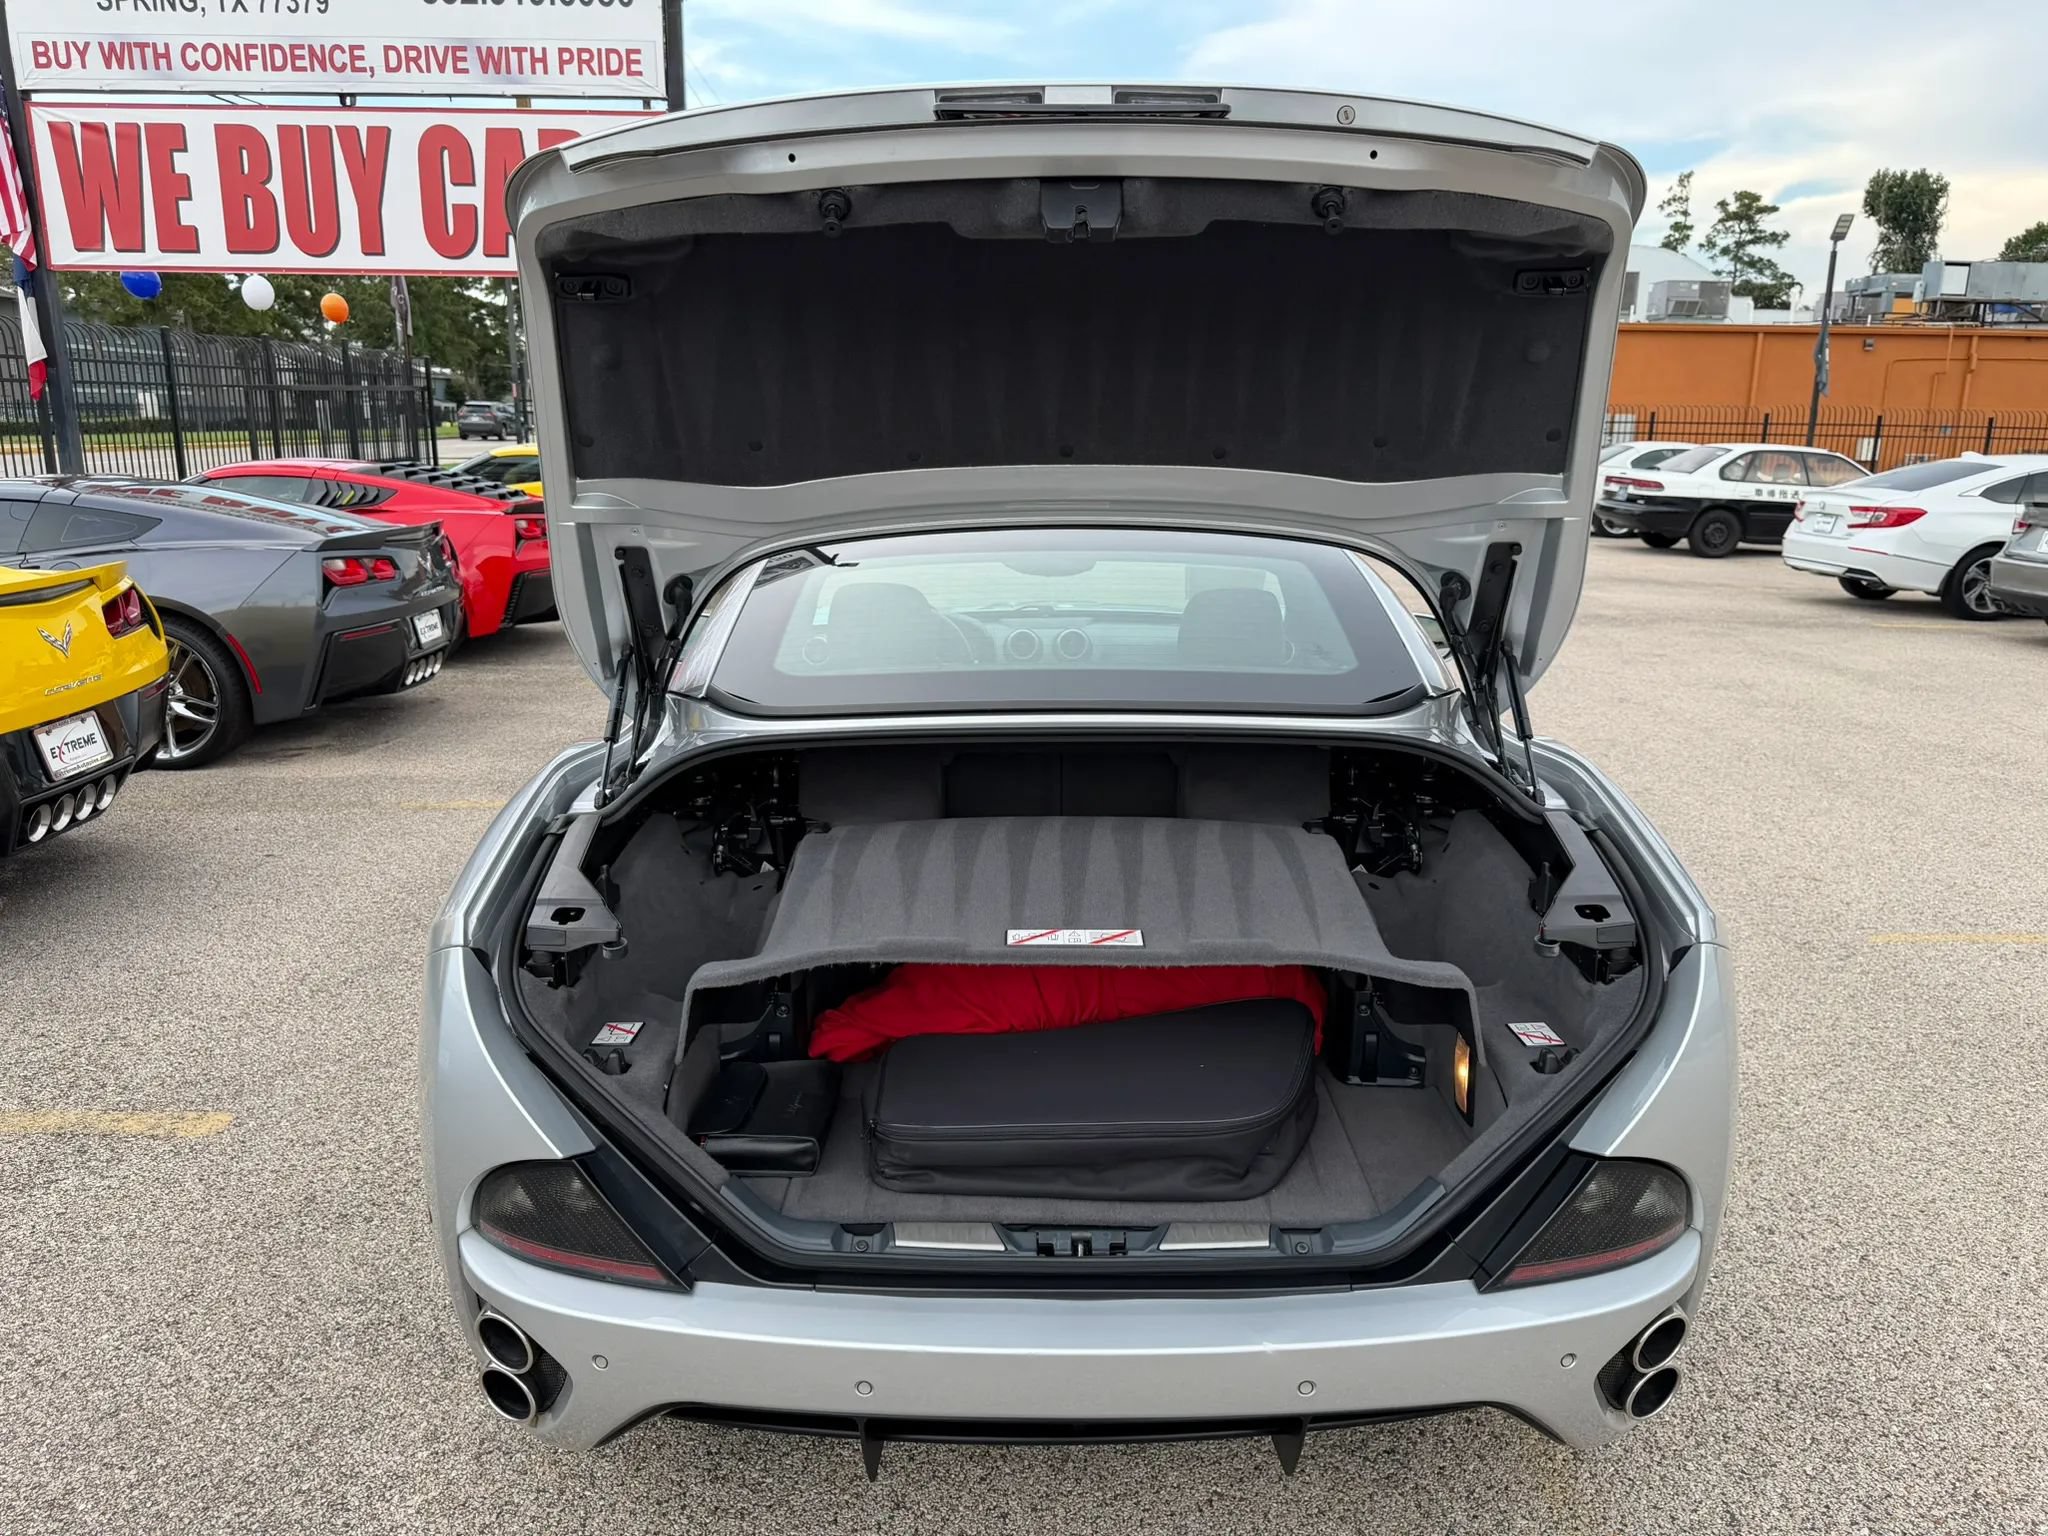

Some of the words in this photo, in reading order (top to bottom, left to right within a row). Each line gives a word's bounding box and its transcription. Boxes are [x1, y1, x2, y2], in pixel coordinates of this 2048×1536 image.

[31, 40, 91, 69] BUY
[98, 41, 172, 71] WITH
[180, 42, 375, 78] CONFIDENCE,
[383, 44, 469, 74] DRIVE
[476, 45, 549, 76] WITH
[557, 47, 643, 77] PRIDE
[47, 121, 201, 253] WE
[213, 123, 391, 257] BUY
[49, 732, 97, 760] EXTREME
